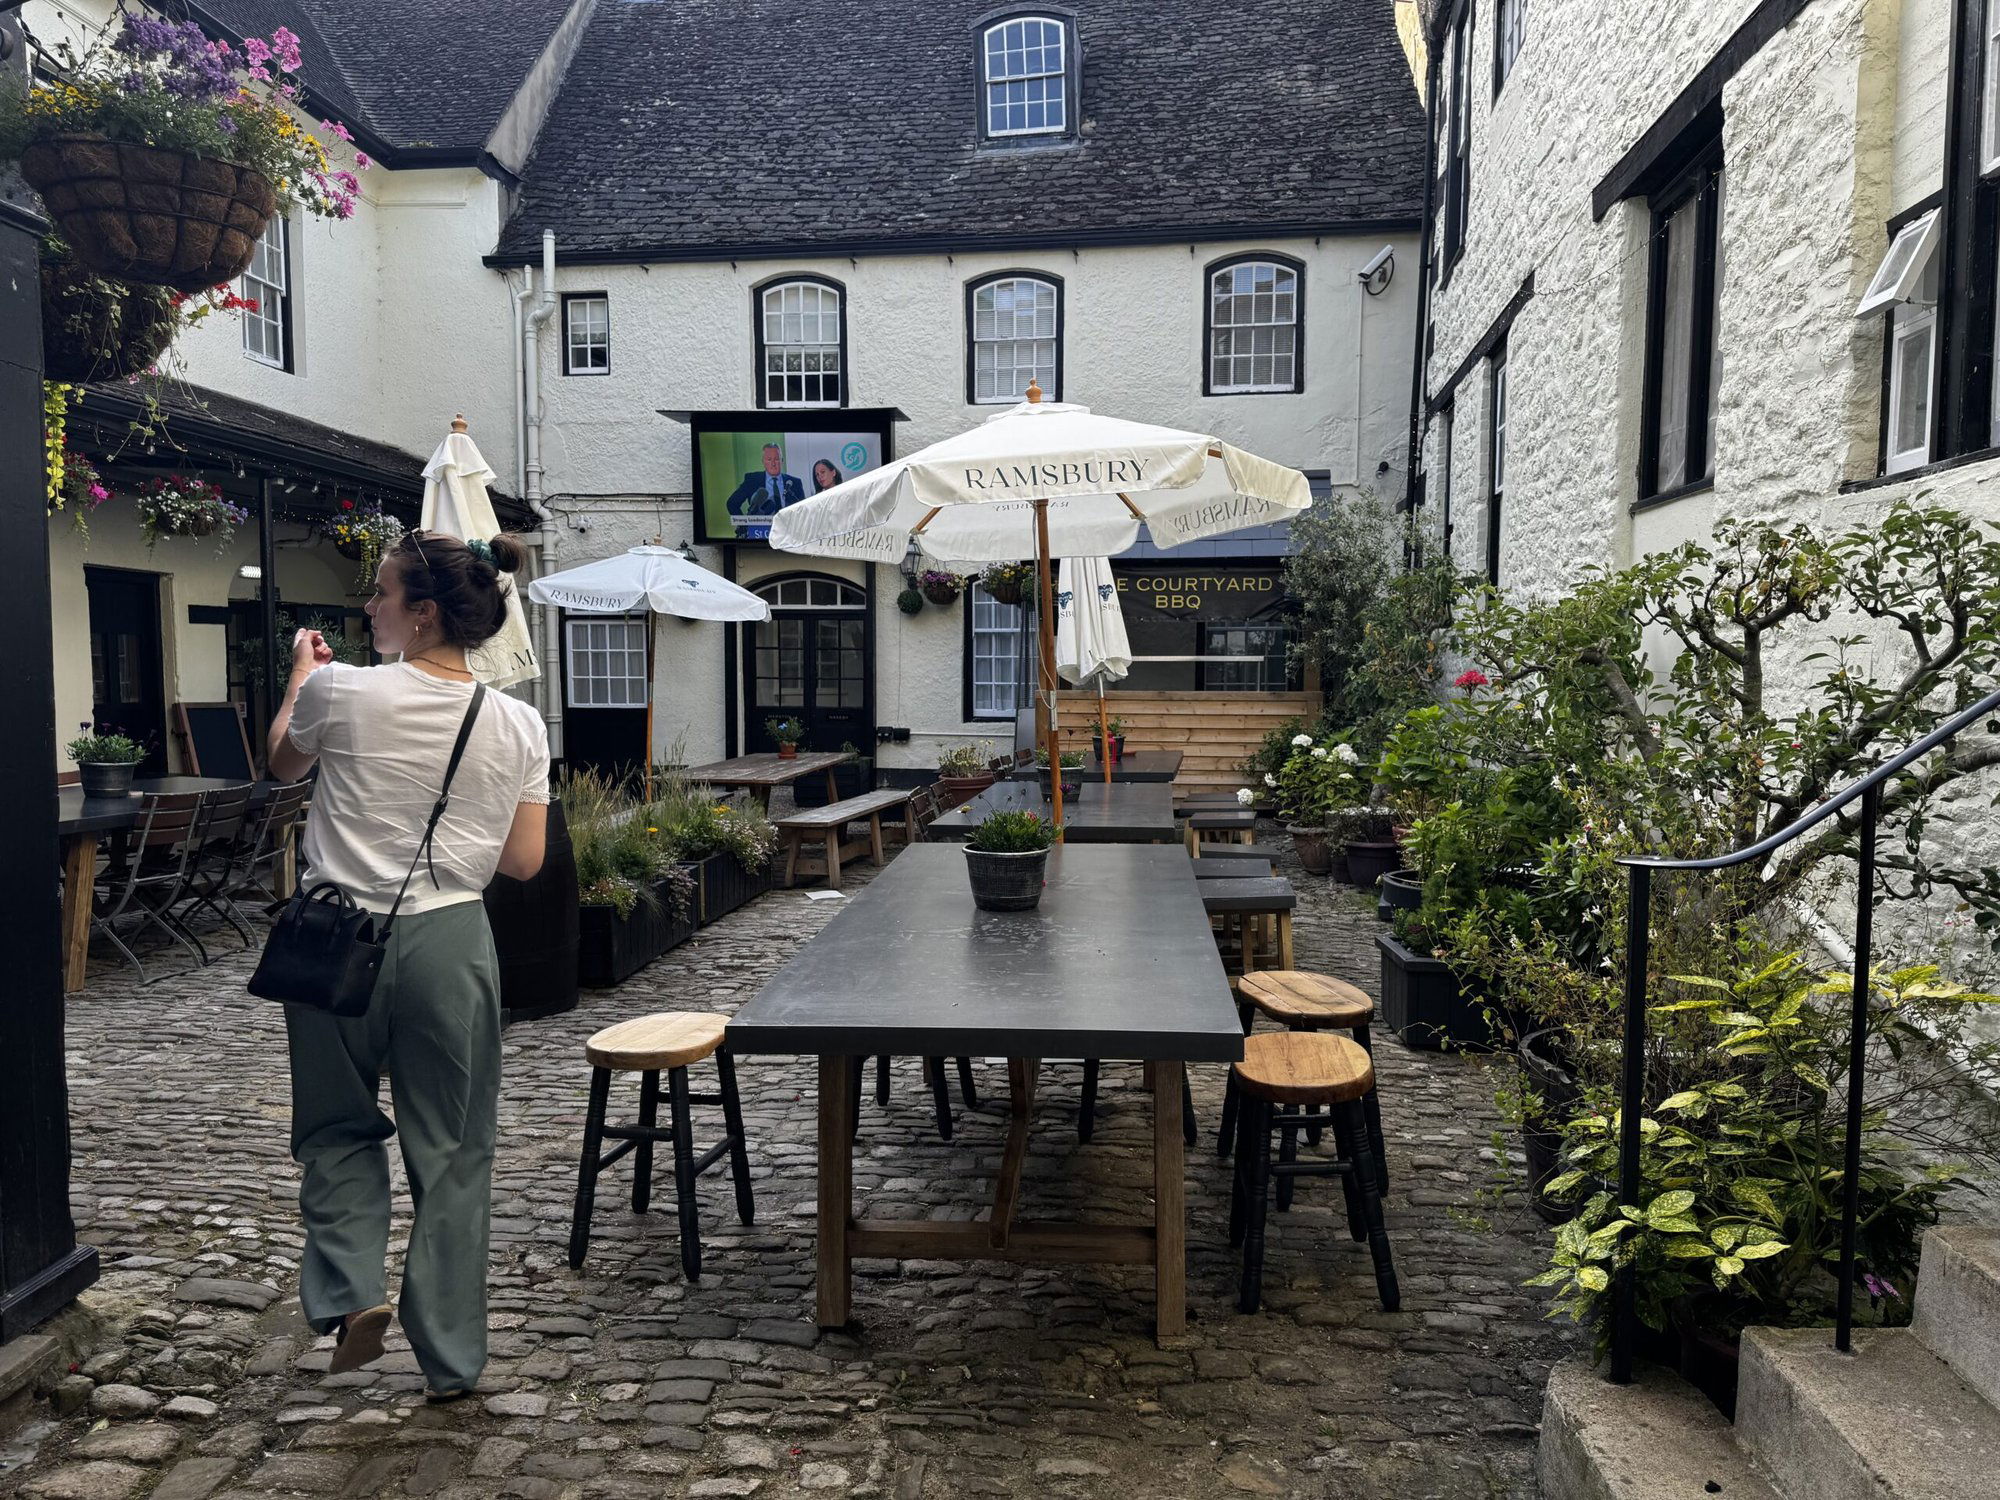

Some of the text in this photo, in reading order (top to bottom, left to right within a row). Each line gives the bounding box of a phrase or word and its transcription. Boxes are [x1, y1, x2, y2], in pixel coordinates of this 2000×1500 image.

[965, 458, 1150, 489] RAMSBURY
[1136, 577, 1273, 592] COURTYARD
[550, 589, 624, 609] RAMSBURY
[1155, 594, 1202, 609] BBQ
